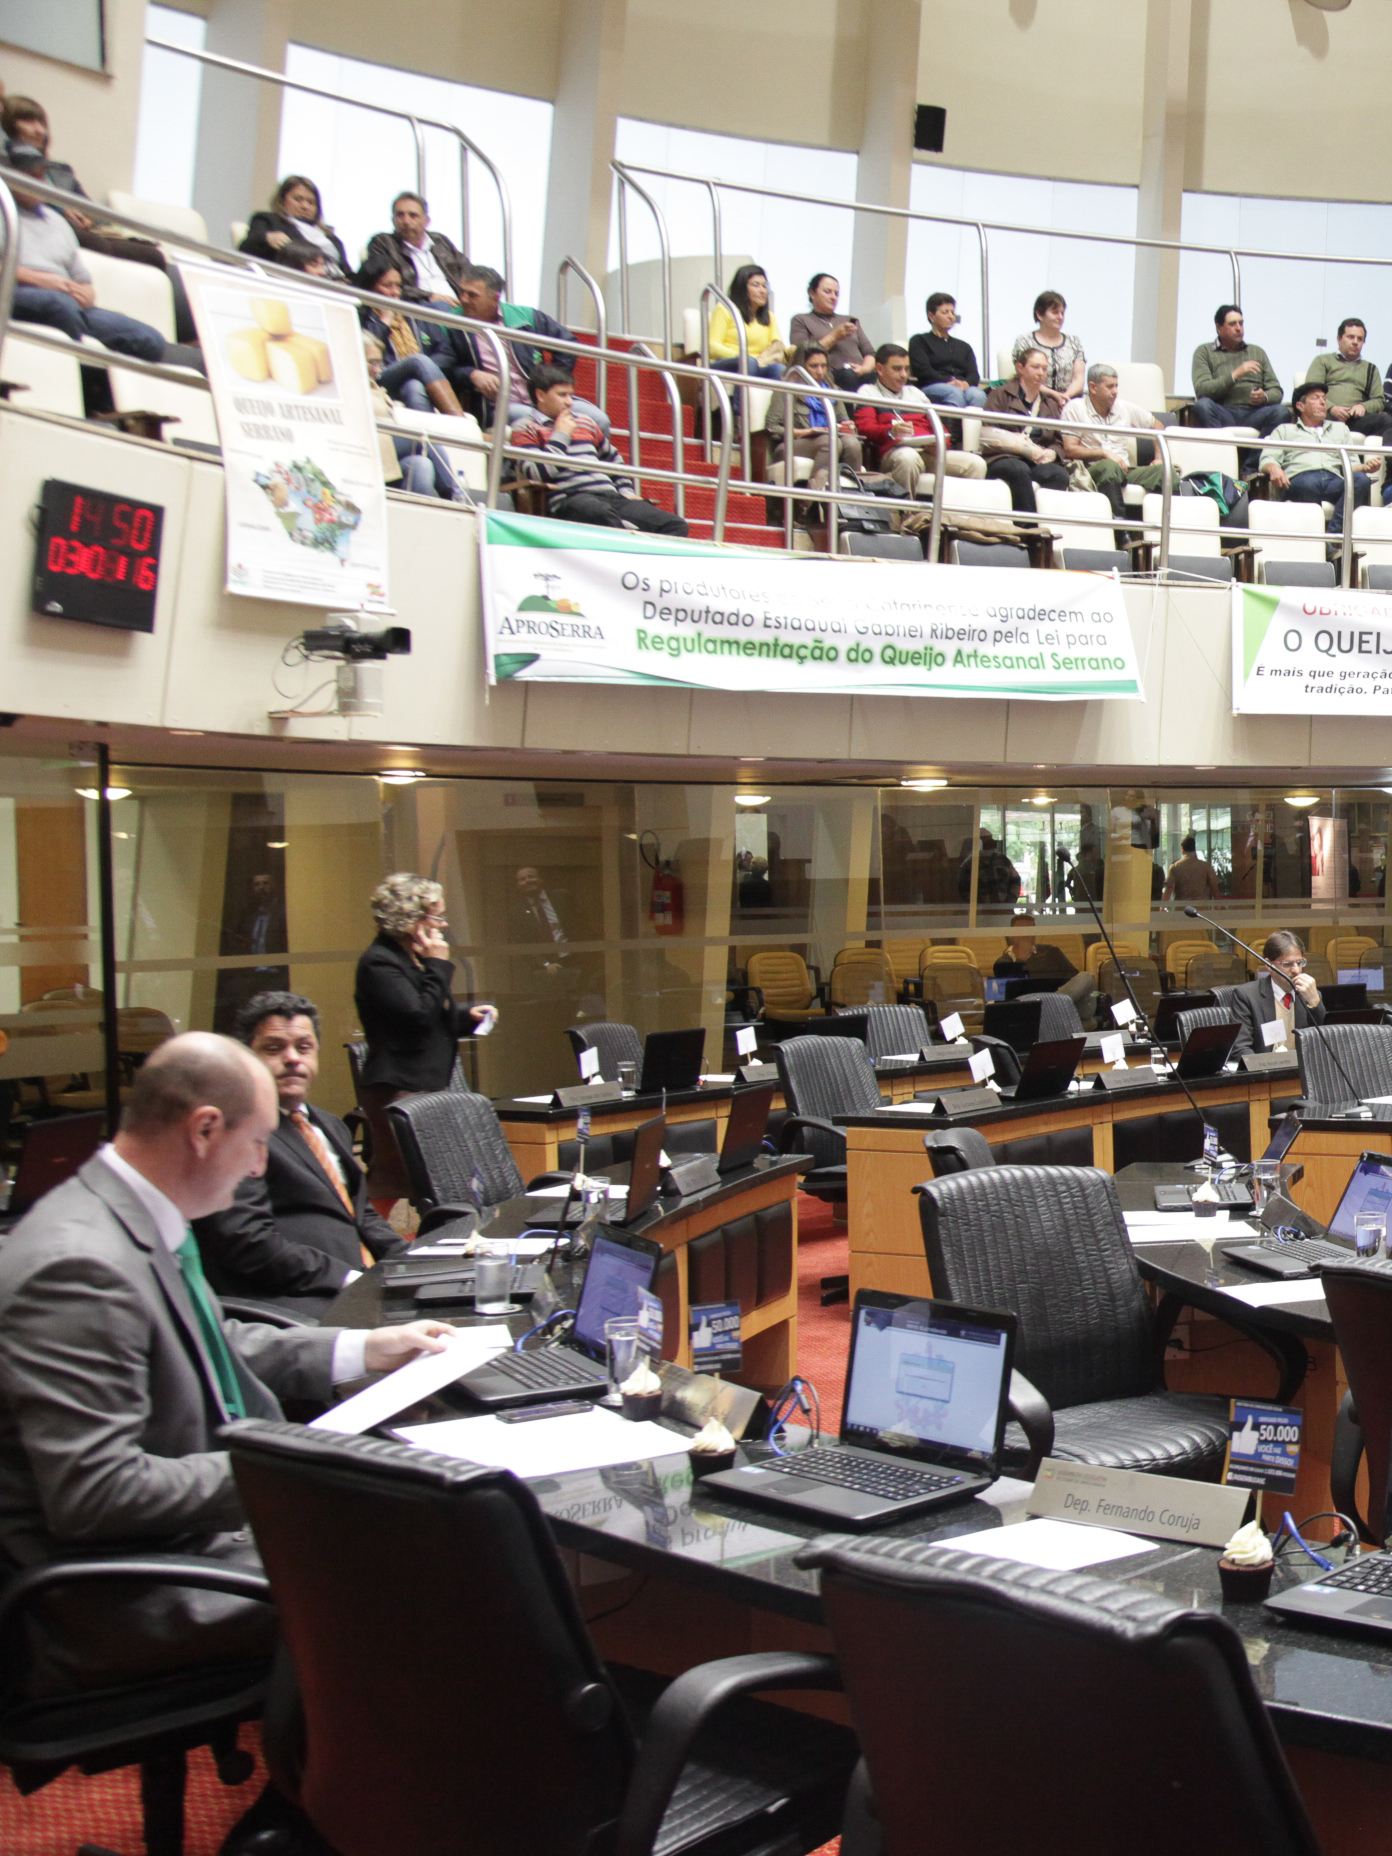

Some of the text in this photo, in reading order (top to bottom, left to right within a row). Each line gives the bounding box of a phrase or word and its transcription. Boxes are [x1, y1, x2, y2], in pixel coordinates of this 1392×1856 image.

[233, 396, 344, 426] QUEIJO ARTESANAL
[240, 421, 294, 443] SERRANO
[621, 571, 651, 592] Os
[659, 578, 769, 604] produtores
[986, 604, 1084, 625] agradecem
[1090, 609, 1114, 624] ao
[642, 600, 755, 629] Deputado
[930, 622, 988, 643] Ribeiro
[992, 627, 1031, 648] pela
[1037, 629, 1060, 646] Lei
[1065, 634, 1108, 650] para
[636, 628, 1126, 672] Regulamentação do Queijo Artesanal Serrano
[1283, 629, 1303, 652] O
[1270, 667, 1304, 679] mais
[1309, 668, 1335, 681] que
[1304, 683, 1367, 697] tradição.
[1260, 1424, 1299, 1442] 50.000
[1064, 1493, 1200, 1533] Dep. Fernando Coruja
